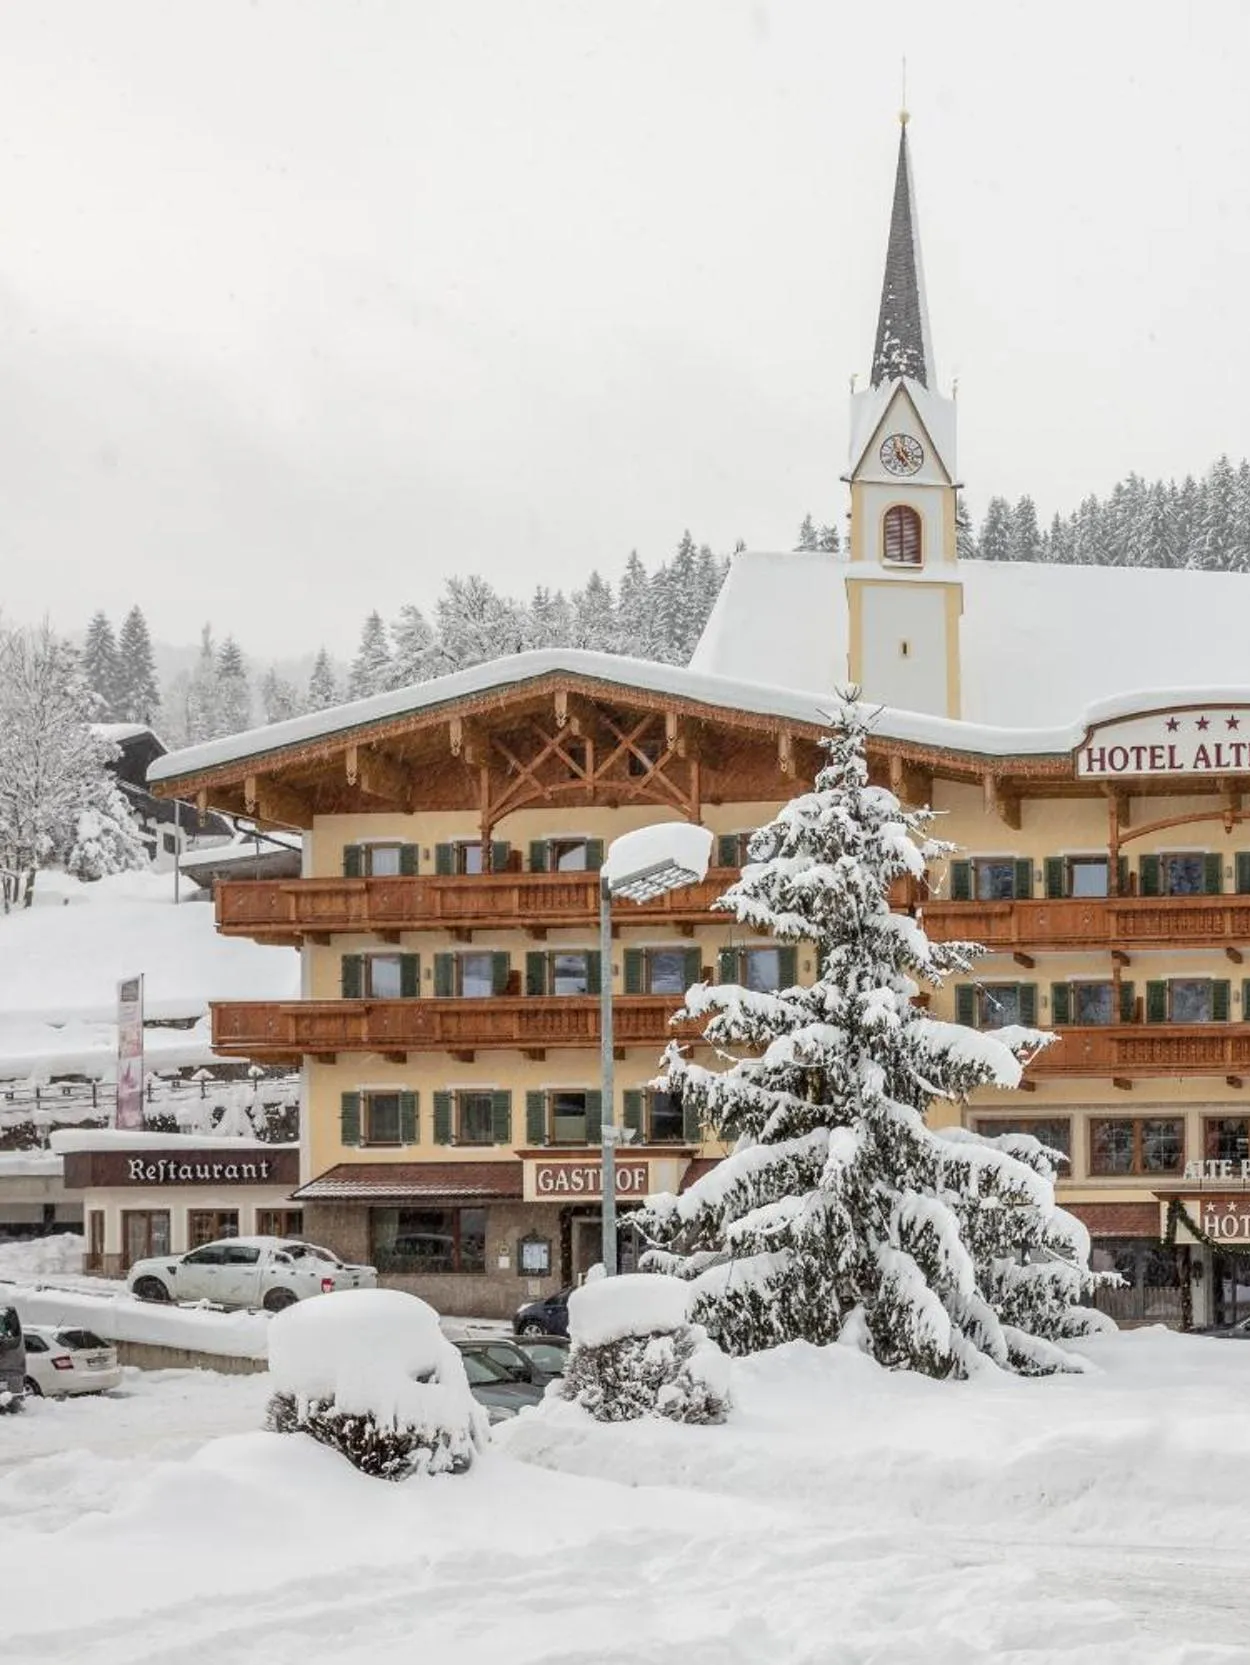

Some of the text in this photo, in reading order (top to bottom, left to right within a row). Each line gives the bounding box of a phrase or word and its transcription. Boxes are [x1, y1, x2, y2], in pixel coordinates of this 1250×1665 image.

[1085, 745, 1184, 772] HOTEL
[538, 1167, 646, 1191] GASTOF
[1183, 1159, 1233, 1180] ALTE
